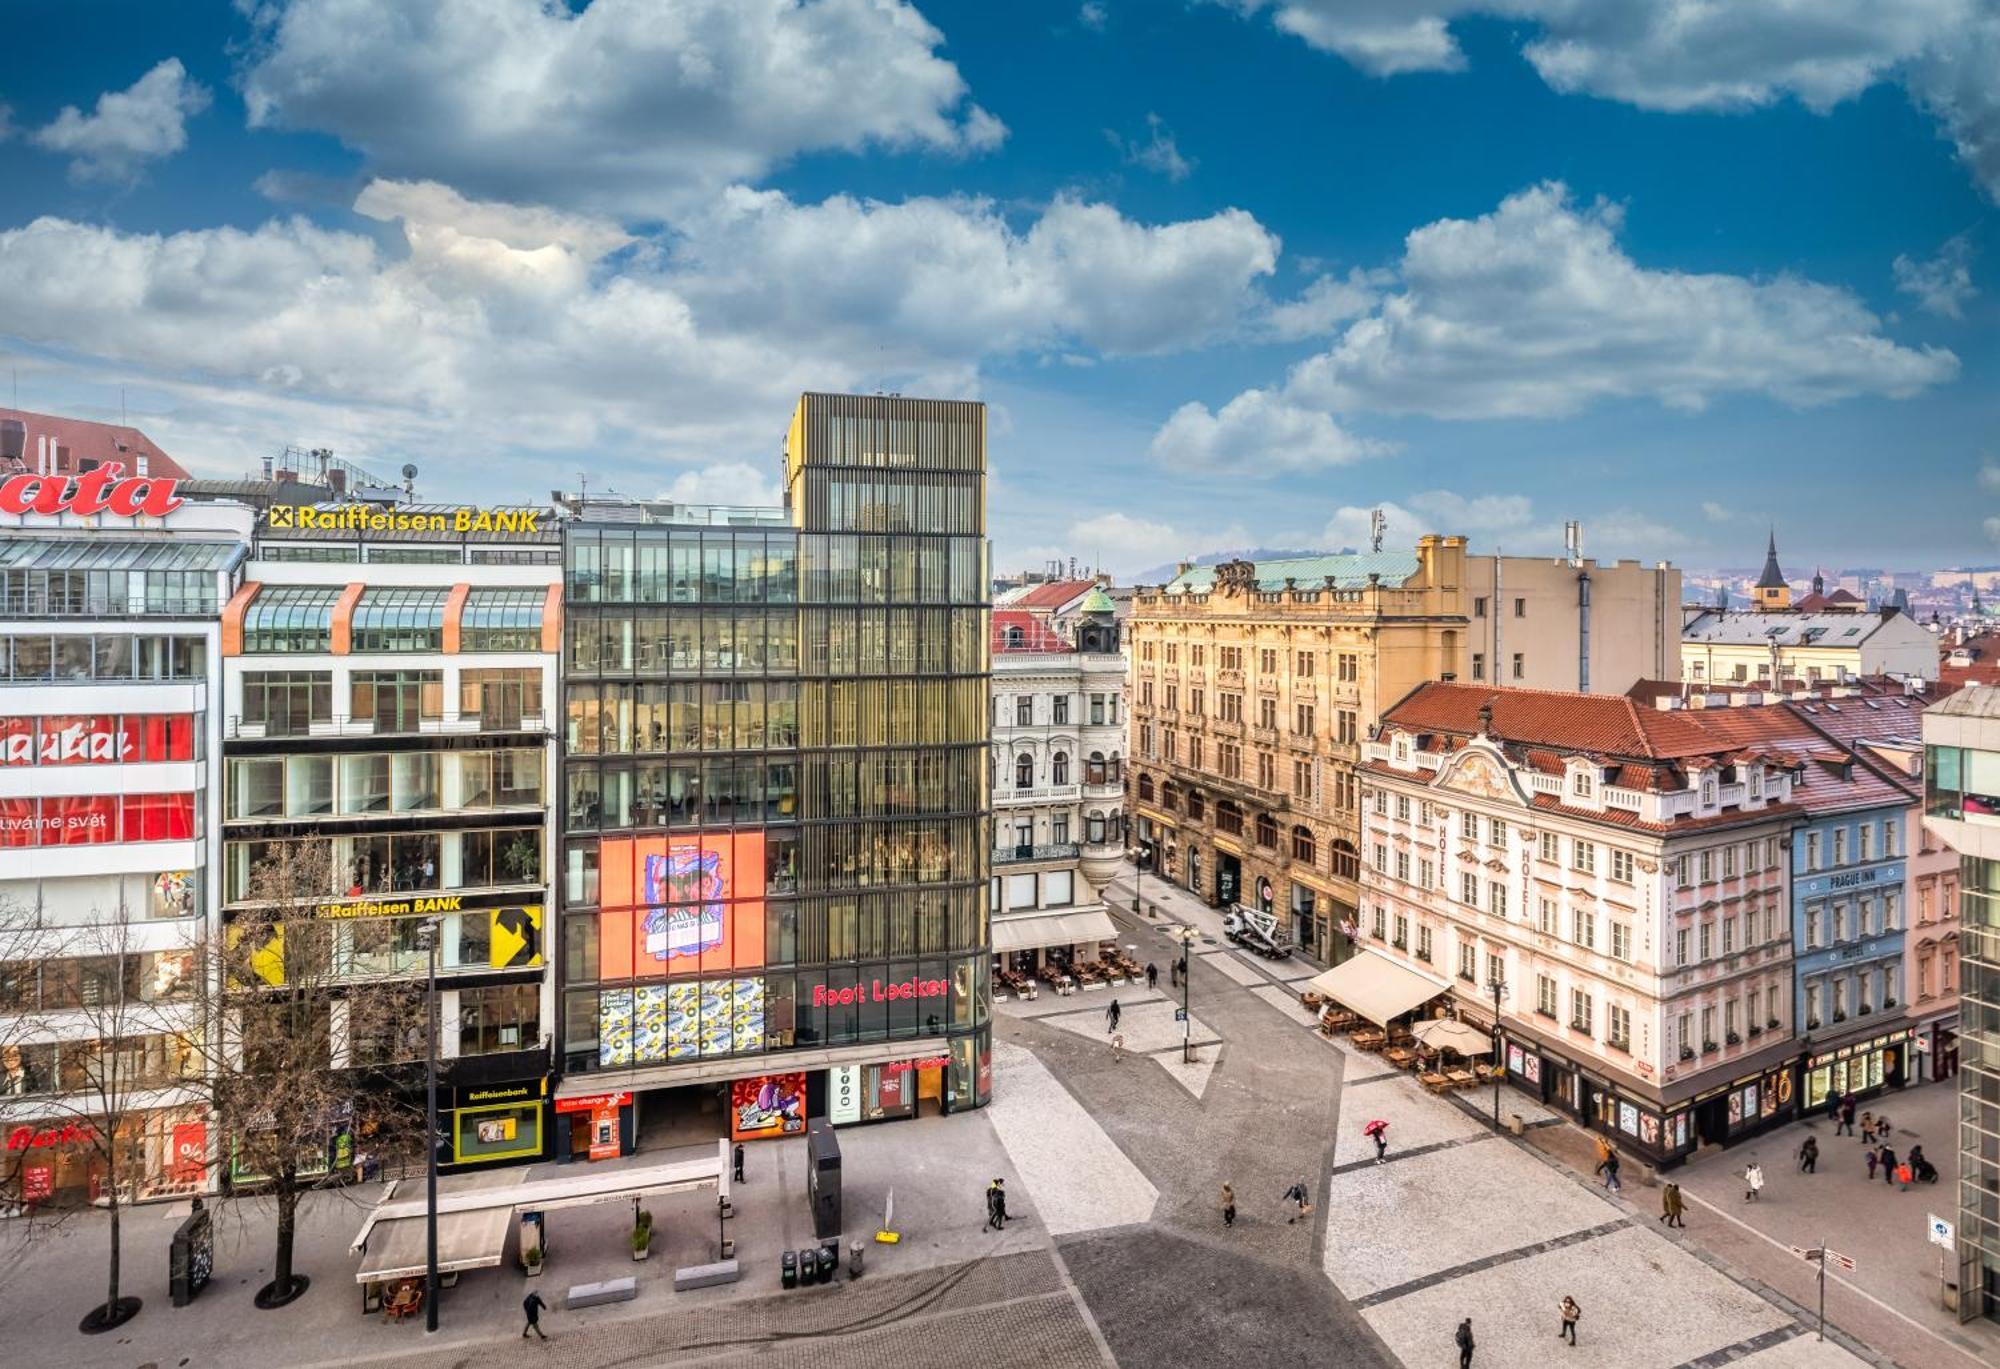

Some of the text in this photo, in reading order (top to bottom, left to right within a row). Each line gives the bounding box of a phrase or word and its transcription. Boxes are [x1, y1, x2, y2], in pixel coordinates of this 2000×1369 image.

[298, 505, 540, 533] Raiffeisen BANK
[67, 813, 107, 828] svět
[1522, 849, 1530, 917] HOTEL
[1830, 869, 1877, 890] PRAGUE INN
[330, 896, 462, 918] Raiffeisen BANK
[812, 976, 951, 1008] Foot Locker
